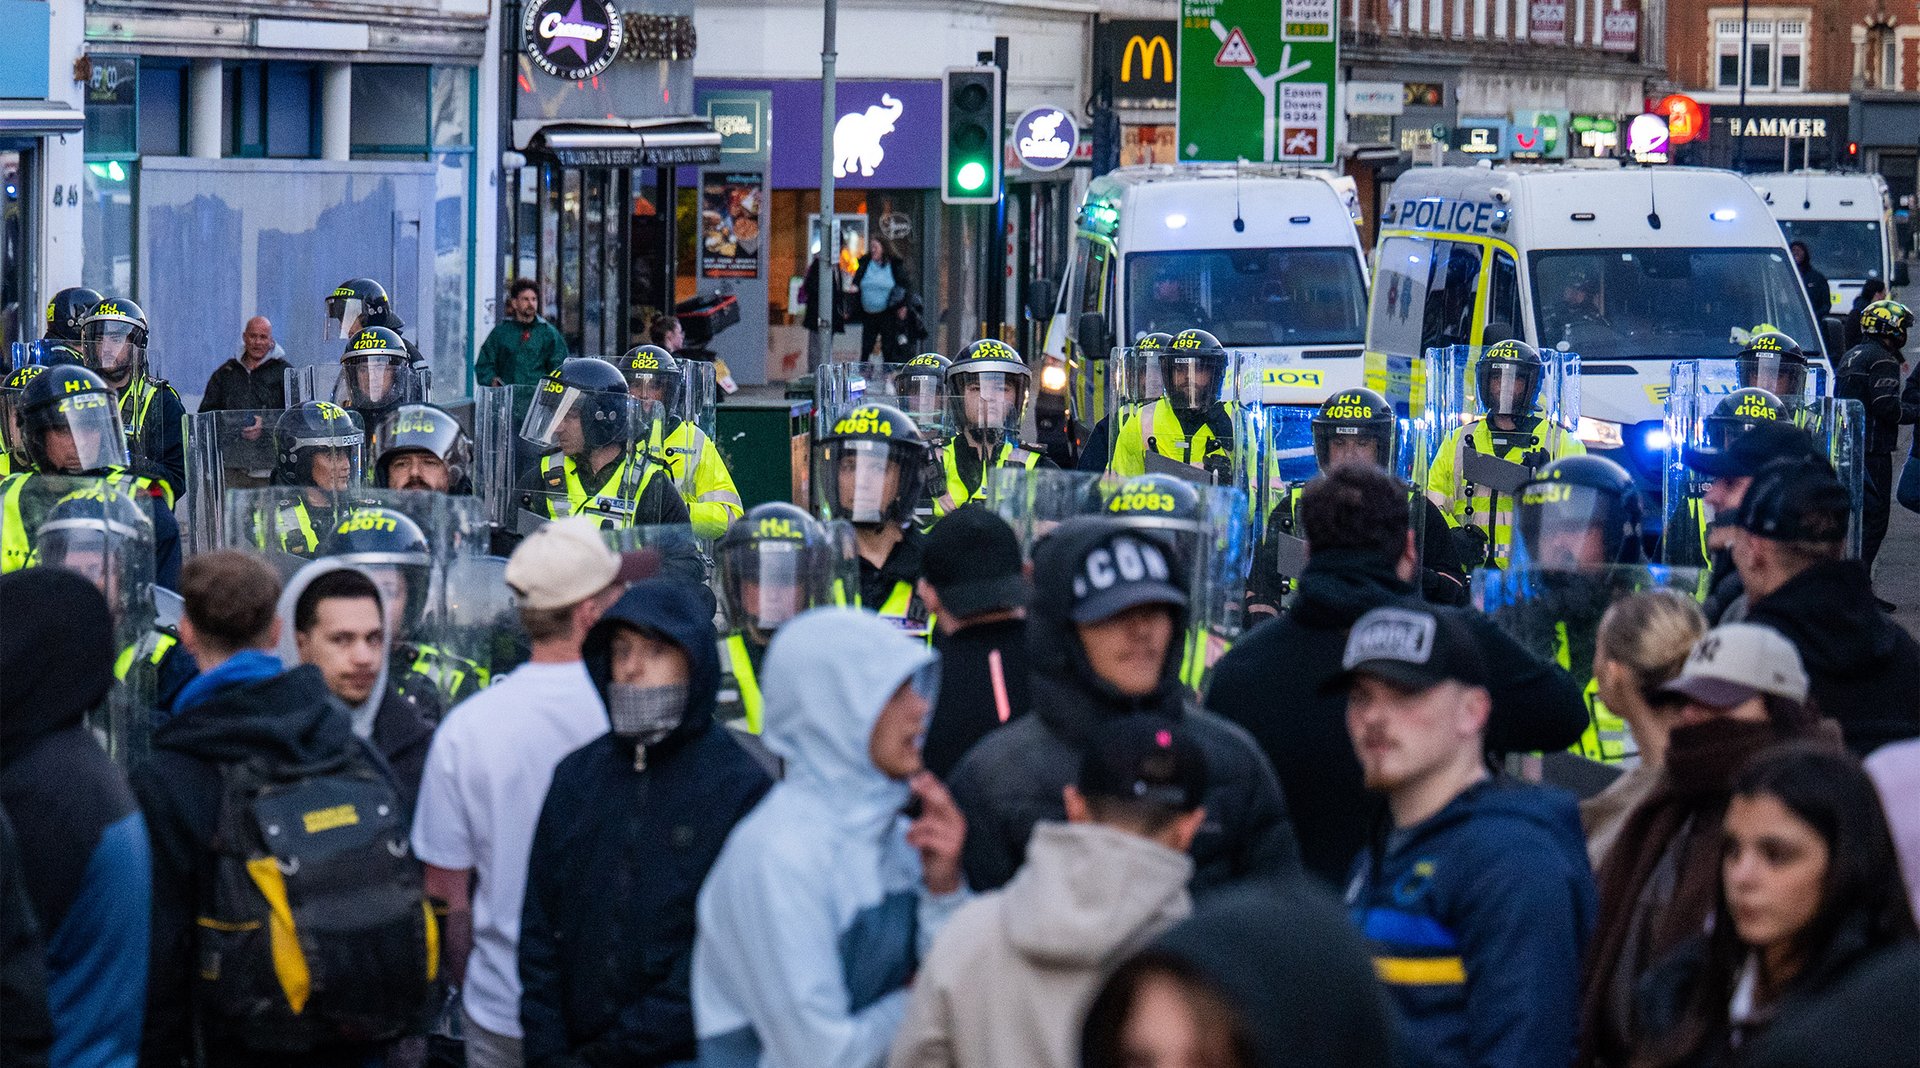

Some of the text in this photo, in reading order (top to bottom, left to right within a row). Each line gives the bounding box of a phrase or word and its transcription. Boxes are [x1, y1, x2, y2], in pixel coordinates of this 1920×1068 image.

[569, 57, 607, 80] COFFEE
[1284, 88, 1321, 98] Epsom
[1284, 101, 1321, 109] Downs
[1400, 200, 1493, 233] POLICE
[100, 303, 117, 311] HJ
[353, 340, 387, 349] 42072
[979, 342, 1002, 350] HJ
[1172, 340, 1201, 349] 4997
[637, 351, 653, 359] HJ
[631, 359, 659, 369] 6822
[909, 358, 940, 369] 4663
[21, 367, 43, 377] HJ
[1338, 395, 1361, 404] HJ
[1744, 396, 1766, 406] HJ
[851, 408, 879, 419] HJ
[1326, 406, 1372, 418] 40566
[1735, 406, 1777, 420] 41645
[834, 419, 892, 437] 40814
[1109, 493, 1175, 512] 42083
[337, 517, 397, 534] 42077
